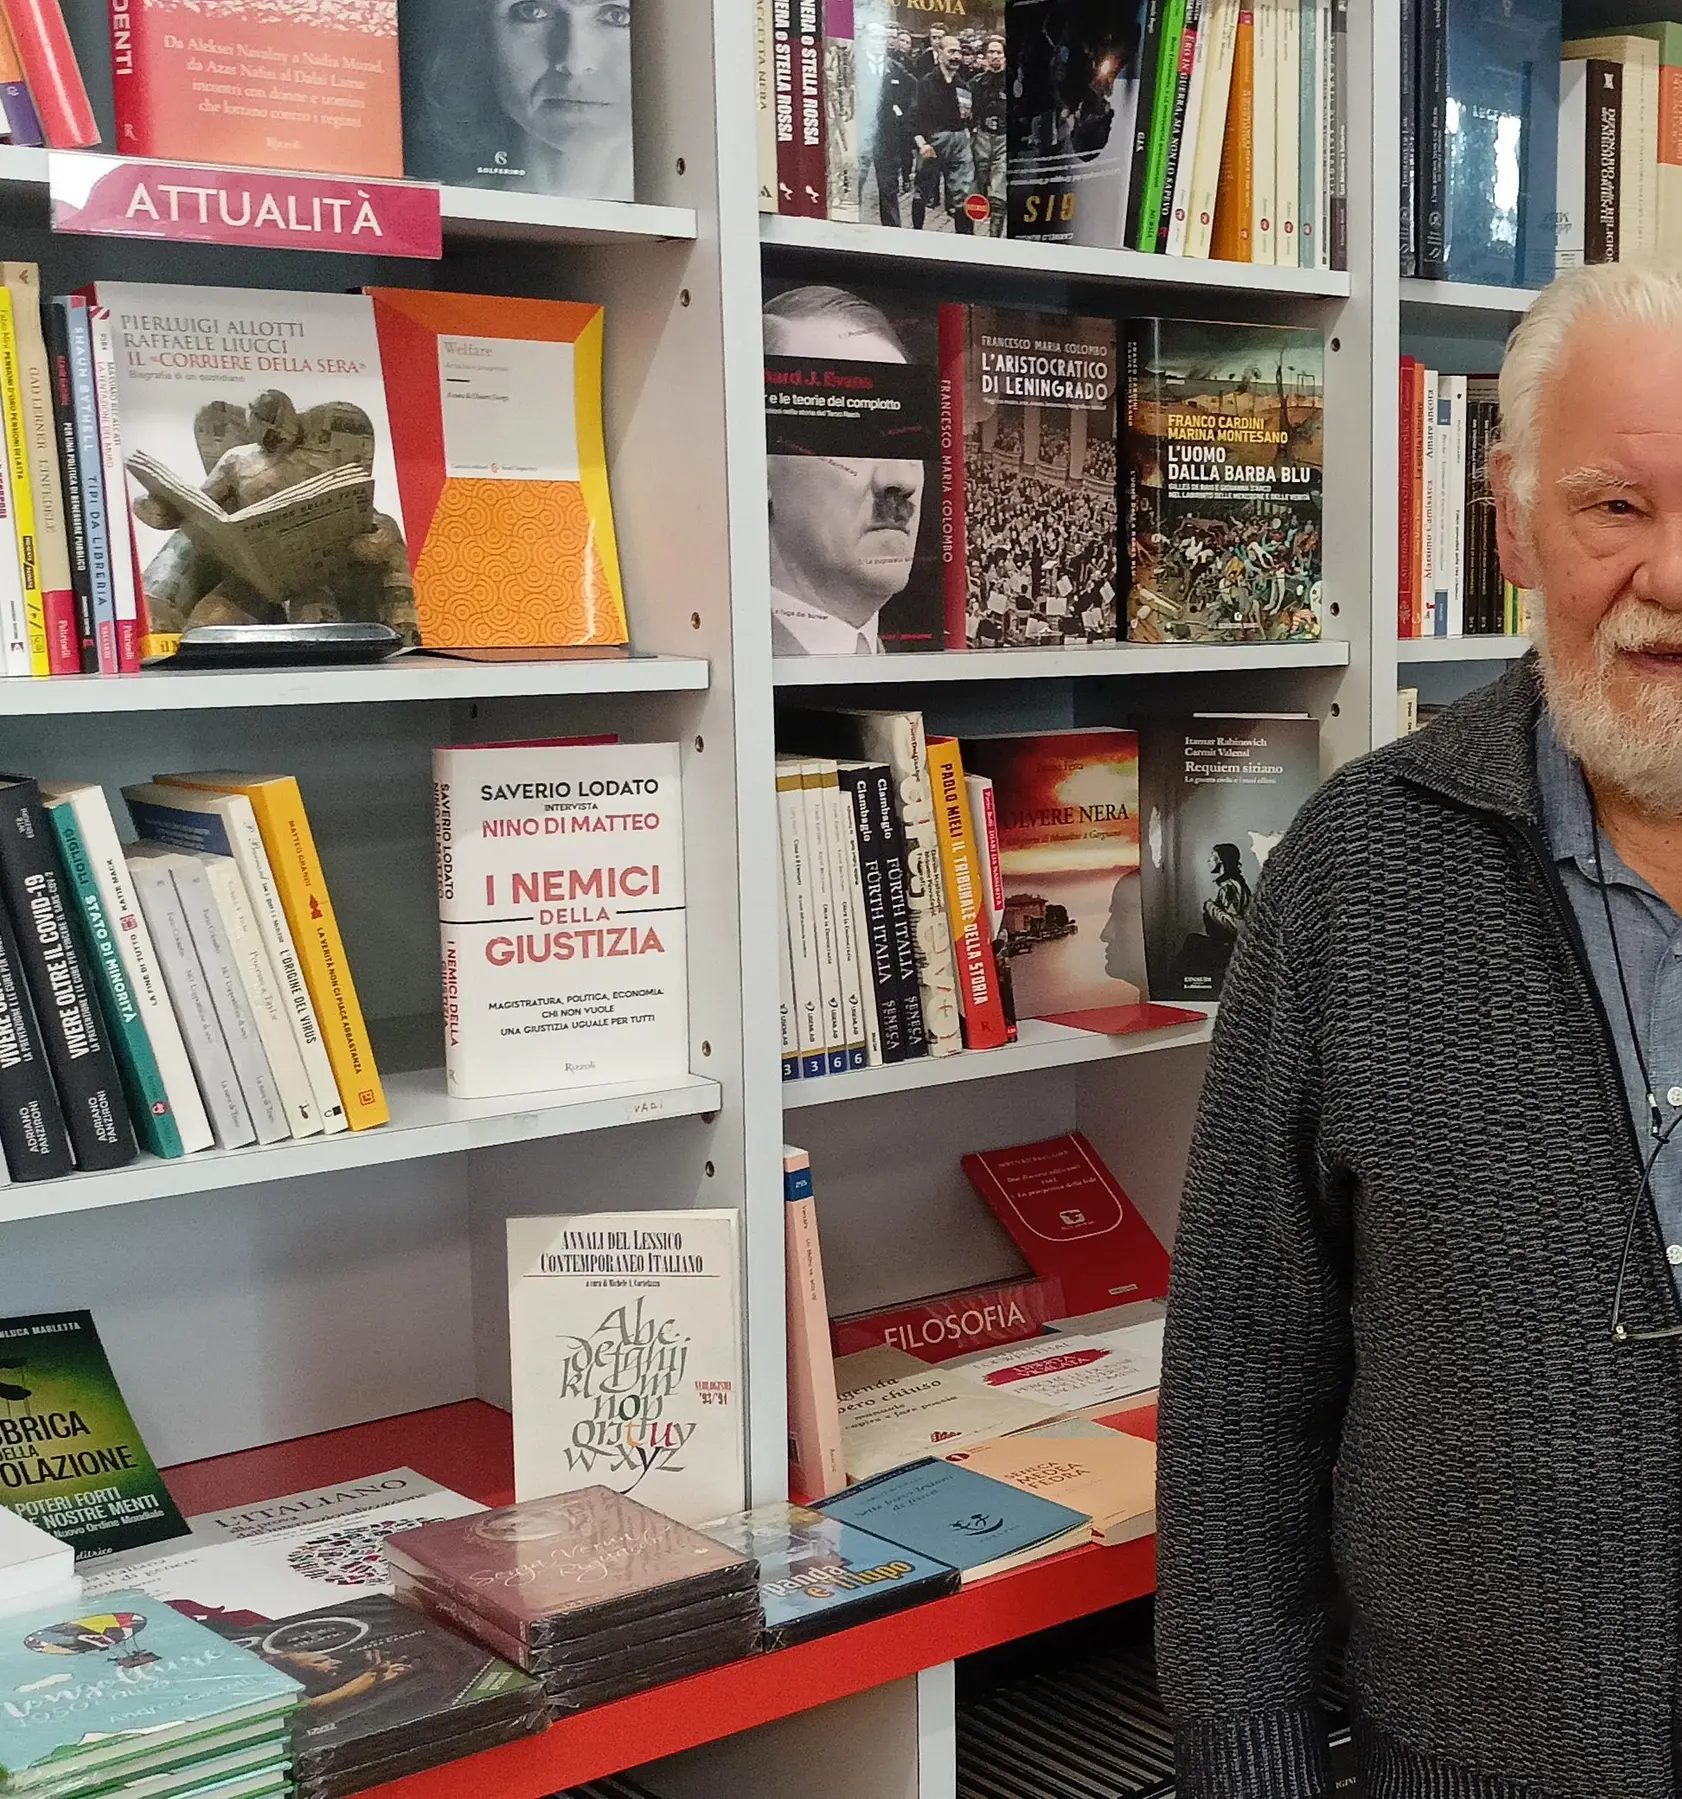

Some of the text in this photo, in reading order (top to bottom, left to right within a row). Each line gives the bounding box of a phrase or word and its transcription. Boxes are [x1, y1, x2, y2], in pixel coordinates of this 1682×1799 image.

[906, 0, 966, 16] ROMA
[775, 43, 793, 142] STELLA ROSSA
[802, 47, 819, 146] STELLA ROSSA
[125, 183, 383, 236] ATTUALITÀ
[1024, 192, 1077, 223] GIS
[121, 315, 305, 337] PIERLUIGI ALLOTTI
[124, 333, 288, 354] RAFFAELE LIUCCI
[982, 336, 1108, 357] FRANCESCO MARIA COLOMBO
[128, 352, 146, 366] IL
[257, 357, 309, 373] DELLA
[981, 352, 1108, 380] L'ARISTOCRATICO
[769, 392, 901, 411] e le teorie del complotto
[981, 374, 1108, 400] DI LENINGRADO
[1167, 427, 1288, 444] MARINA MONTESANO
[1168, 414, 1264, 430] FRANCO CARDINI
[1168, 445, 1226, 464] L'UOMO
[940, 379, 953, 563] FRANCESCO MARIA COLOMBO
[1168, 463, 1311, 483] DALLA BARBA BLU
[88, 476, 108, 606] TIPI DA LIBRERIA
[1185, 761, 1283, 775] Requiem siriano
[481, 778, 659, 801] SAVERIO LODATO
[544, 802, 599, 812] INTERVISTA
[1080, 804, 1129, 823] NERA
[482, 812, 660, 838] NINO DI MATTEO
[440, 783, 454, 900] SAVERIO LODATO
[65, 828, 90, 886] GIGLIOLI
[486, 865, 660, 906] I NEMICI
[940, 763, 987, 1005] PAOLO MIELI IL TRIBUNALE DELLA STORIA
[540, 906, 611, 925] DELLA
[85, 895, 137, 1024] STATO DI MINORITÀ
[130, 934, 144, 960] TUTTO
[485, 926, 665, 966] GIUSTIZIA
[25, 873, 90, 1061] VIVERE OLTRE IL COVID-19
[279, 949, 317, 1045] L'ORIGINE DEL VIRUS
[873, 923, 893, 985] ITALIA
[887, 1000, 900, 1050] SENECA
[897, 921, 914, 981] ITALIA
[909, 995, 922, 1045] SENECA
[447, 949, 459, 1047] NEMICI DELLA
[488, 992, 610, 1011] MAGISTRATURA, POLITICA,
[542, 1004, 615, 1019] CHI NON VUOLE
[327, 967, 340, 987] NON
[336, 997, 350, 1020] PIACE
[343, 1021, 363, 1075] ABBASTANZA
[500, 1014, 655, 1036] UNA GIUSTIZIA UGUALE PER TUTTI
[0, 1015, 21, 1070] VIVERE
[784, 1053, 862, 1075] 3 3 6 6
[19, 1100, 50, 1155] ADRIANO PANZIRONI
[88, 1090, 118, 1145] ADRIANO PANZIRONI
[562, 1230, 682, 1250] ANNALI DEL LESSICO
[540, 1252, 703, 1273] CONTEMPORANEO ITALIANO
[884, 1301, 1026, 1350] FILOSOFIA
[881, 1379, 942, 1402] chiuso
[0, 1410, 91, 1446] BRICA
[0, 1445, 138, 1488] OLAZIONE
[1005, 1461, 1061, 1480] SENECA
[1016, 1461, 1083, 1486] MEDEA
[1028, 1467, 1091, 1490] FEDRA
[15, 1486, 121, 1518] POTERI FORTI
[42, 1493, 160, 1531] NOSTRE MENTI
[215, 1477, 409, 1531] L'ITALIANO
[53, 1508, 165, 1540] Nuovo Ordine Mondiale
[761, 1563, 846, 1597] panda
